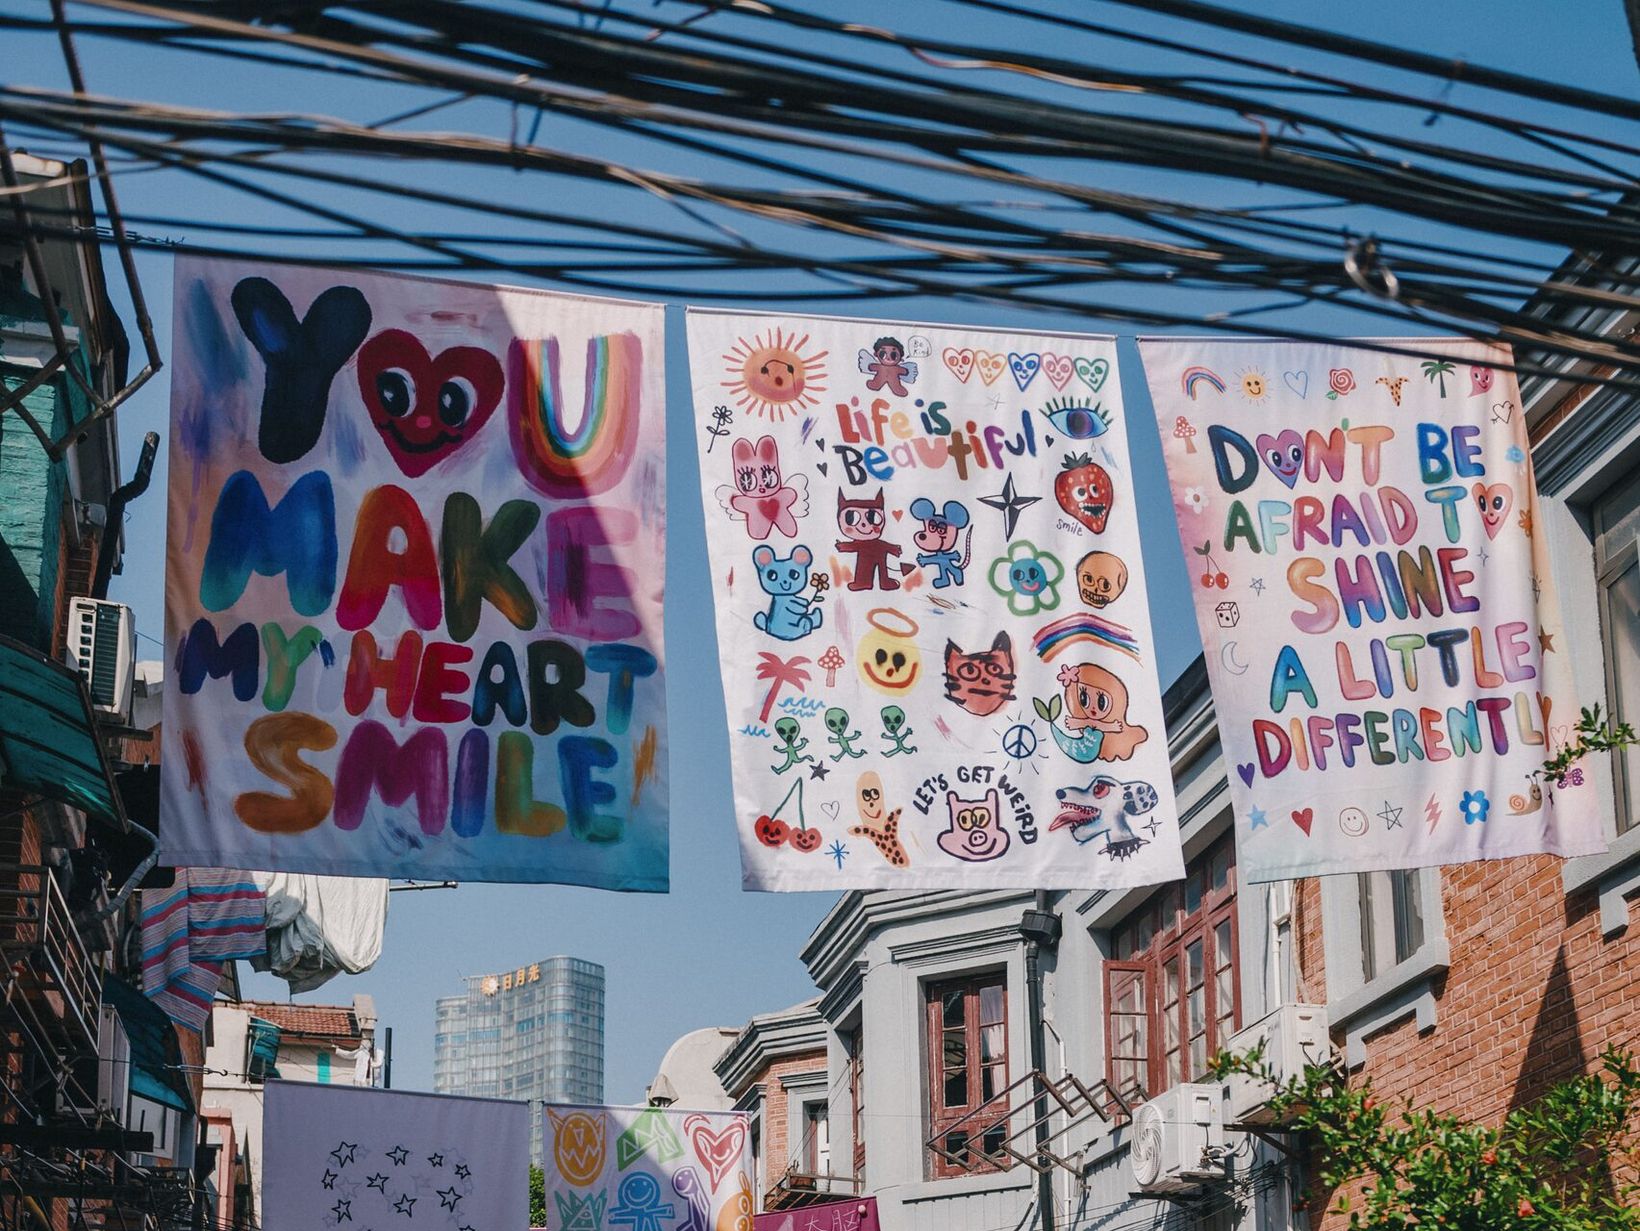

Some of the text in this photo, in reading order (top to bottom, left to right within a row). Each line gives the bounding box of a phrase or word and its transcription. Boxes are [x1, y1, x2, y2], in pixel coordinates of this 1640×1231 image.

[832, 409, 1037, 486] Beautiful
[836, 395, 951, 447] Life is
[1416, 422, 1485, 484] BE
[200, 469, 642, 642] MAKE
[1223, 485, 1418, 555] AFRAID
[1286, 544, 1481, 635] SHINE
[177, 617, 657, 735] MY HEART
[1269, 621, 1537, 714] A LITTLE
[1252, 691, 1553, 779] DIFFERENTLY
[234, 710, 626, 843] SMILE
[912, 773, 949, 816] LET'S
[957, 765, 995, 784] GET
[502, 963, 541, 990] 日月光
